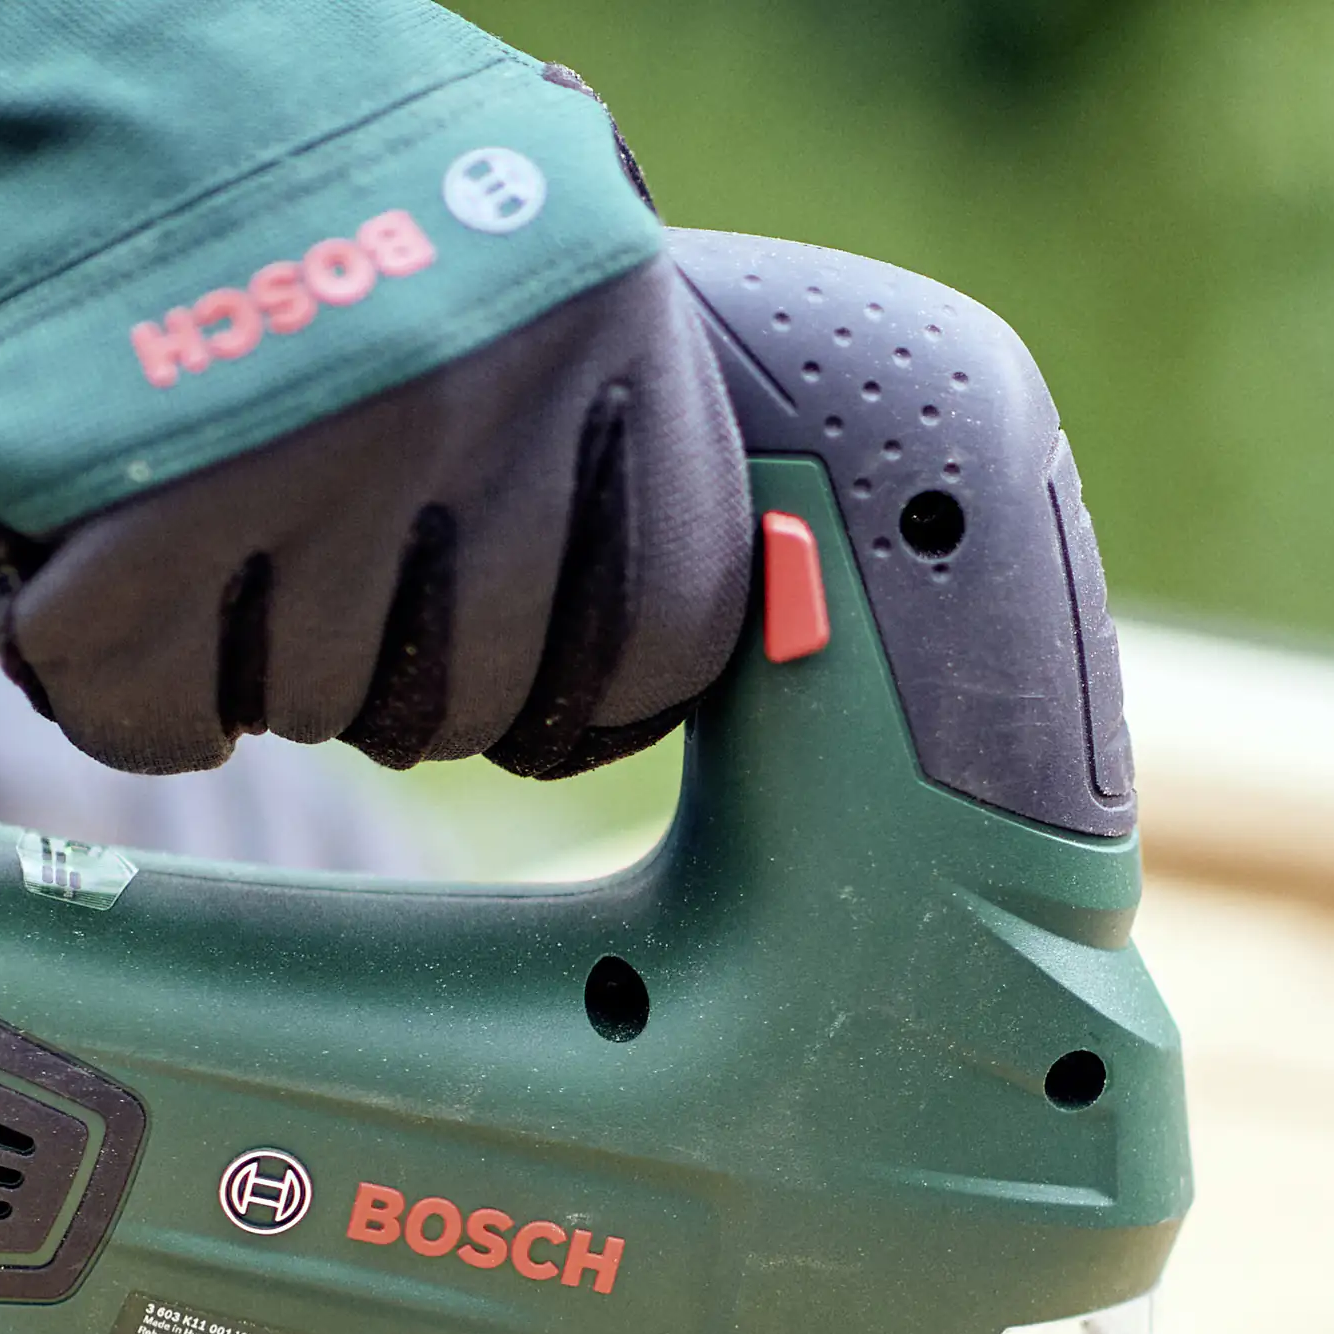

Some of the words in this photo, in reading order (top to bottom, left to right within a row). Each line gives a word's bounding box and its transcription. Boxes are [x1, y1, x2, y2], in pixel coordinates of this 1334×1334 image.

[130, 209, 437, 388] BOSCH
[346, 1181, 625, 1294] BOSCH
[142, 1315, 171, 1331] Made
[171, 1324, 183, 1334] in
[145, 1303, 155, 1314] 3
[156, 1306, 181, 1322] 603
[182, 1315, 207, 1331] K11
